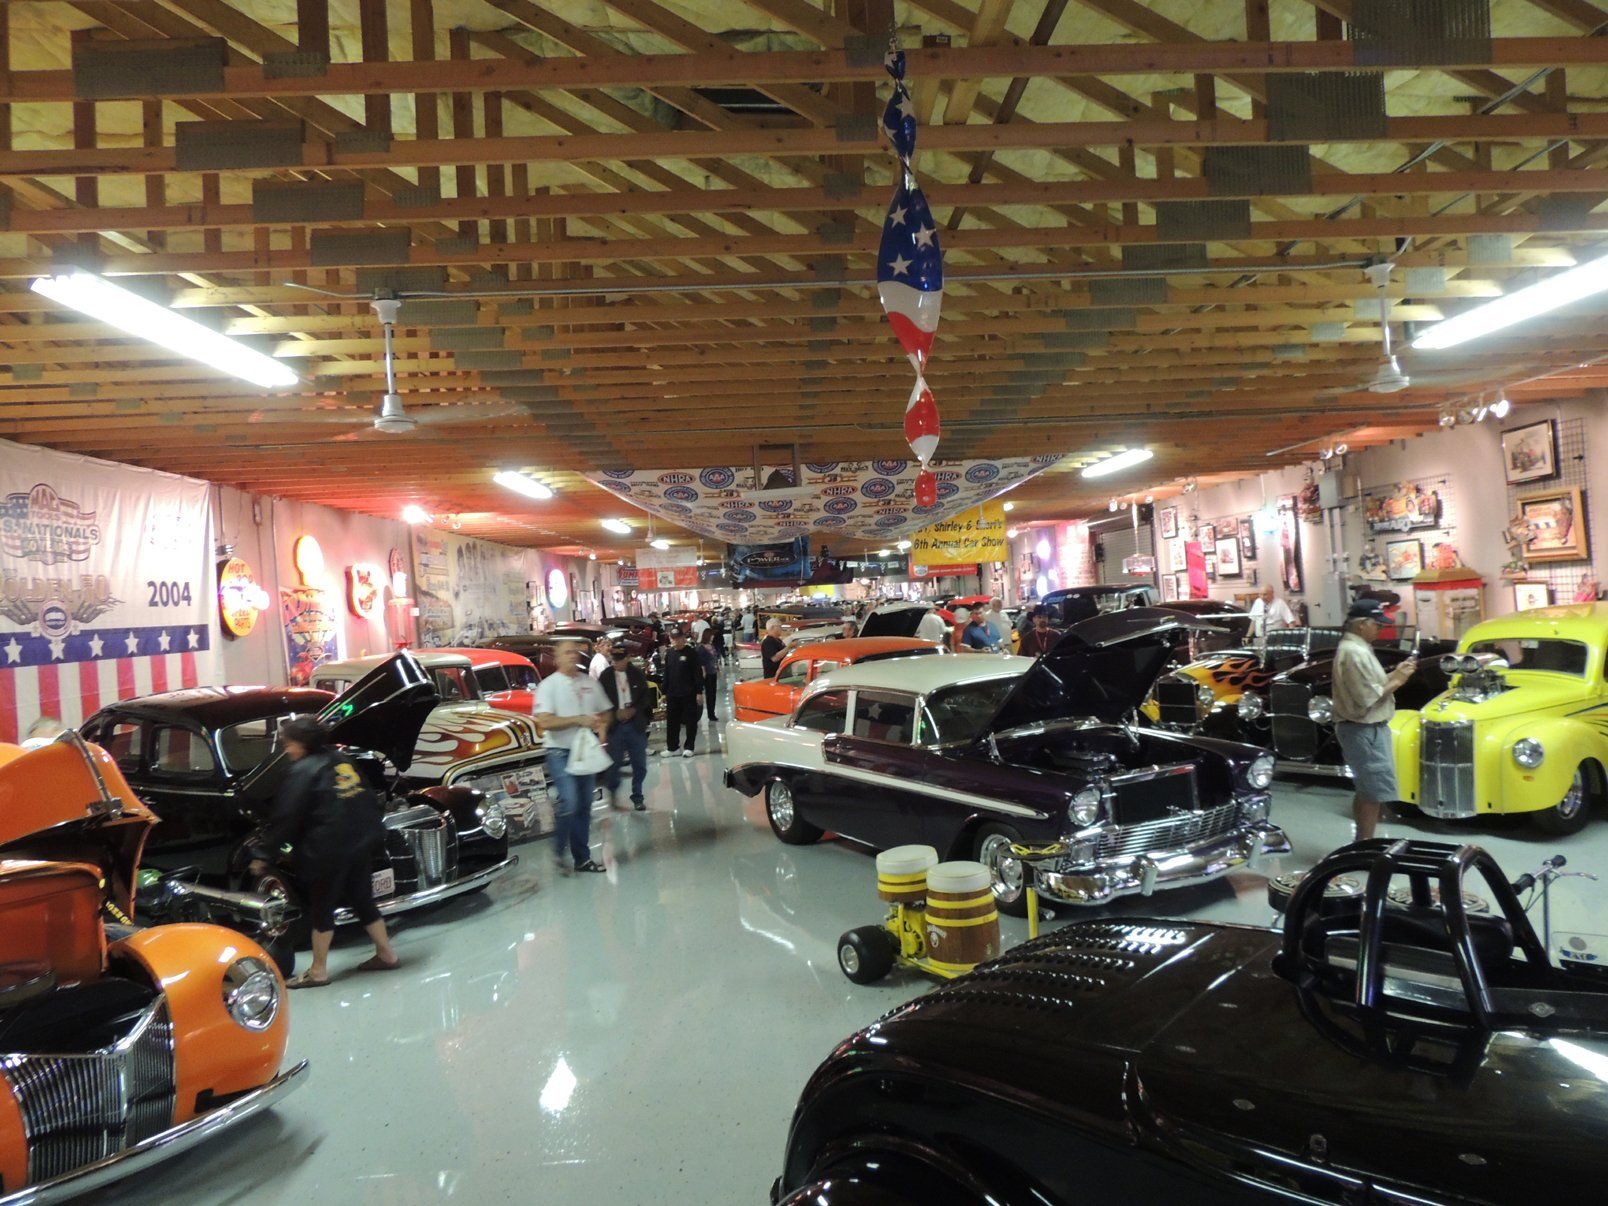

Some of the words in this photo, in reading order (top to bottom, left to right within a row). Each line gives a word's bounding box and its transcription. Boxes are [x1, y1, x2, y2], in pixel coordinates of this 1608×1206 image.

[662, 474, 694, 484] NHRA
[708, 472, 726, 481] AAA
[935, 471, 960, 481] HRA
[825, 486, 854, 497] NHRA
[869, 484, 887, 493] AAA
[721, 501, 752, 510] NHRA
[879, 506, 906, 516] NHRA
[934, 520, 963, 533] Shirley
[22, 522, 99, 543] NATIONALS
[931, 538, 961, 549] Annual
[964, 537, 978, 548] Car
[981, 536, 1005, 547] Show
[228, 562, 247, 574] HOT
[147, 580, 192, 607] 2004
[371, 876, 392, 892] ORD
